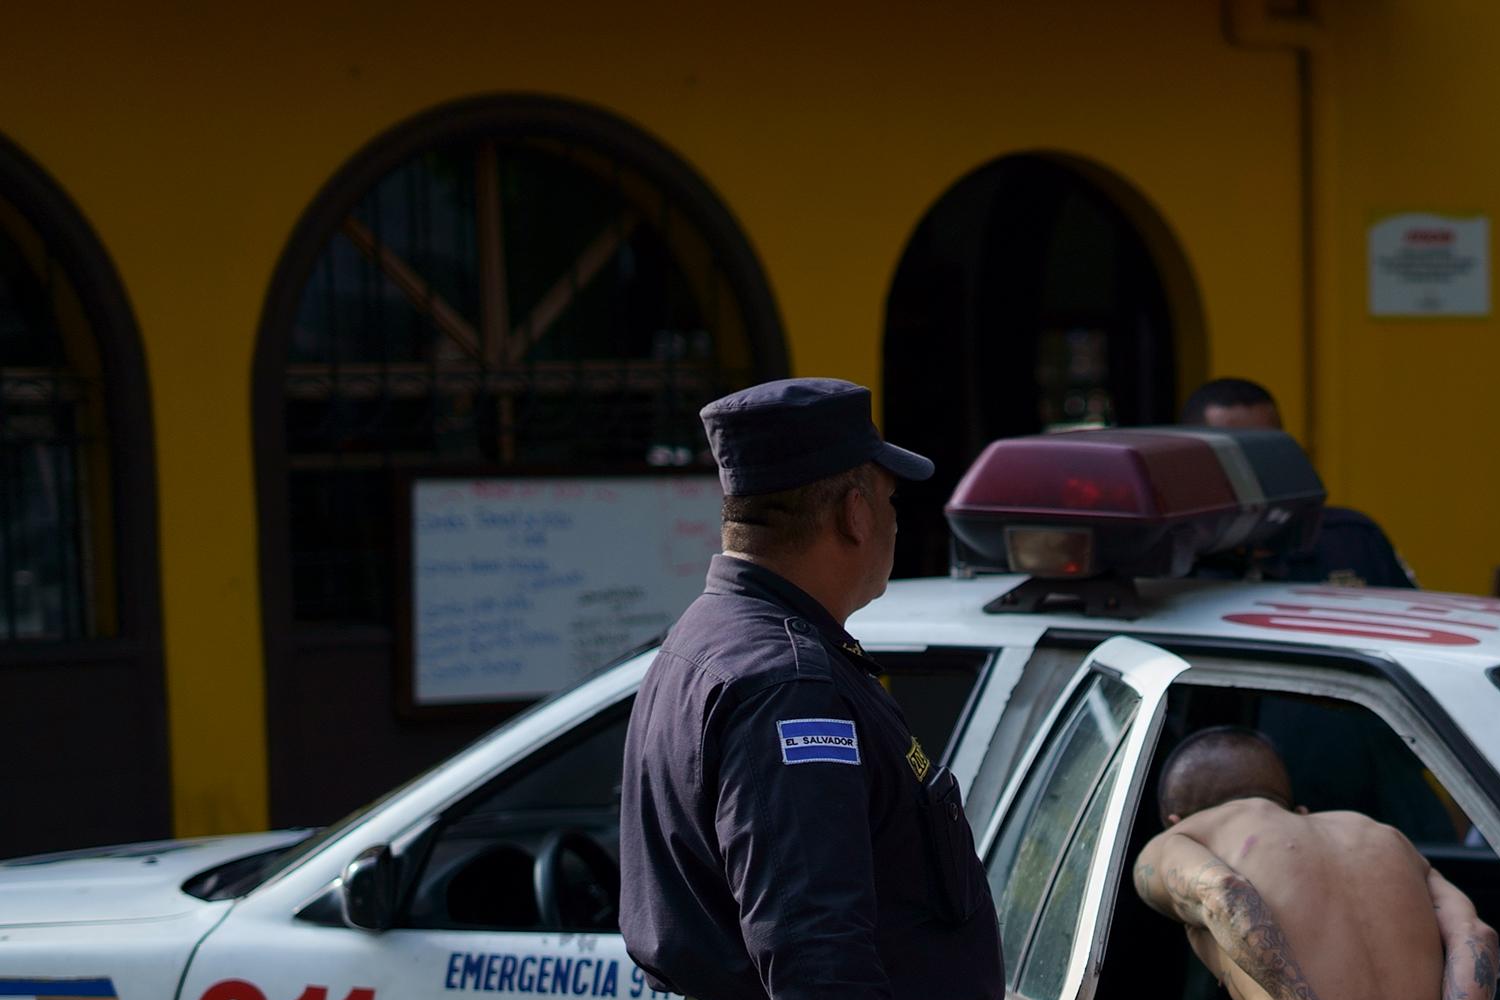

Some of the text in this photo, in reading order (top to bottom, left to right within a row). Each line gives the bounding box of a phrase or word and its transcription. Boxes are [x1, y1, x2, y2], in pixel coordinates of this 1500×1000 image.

[786, 736, 853, 747] EL SALVADOR
[444, 951, 620, 998] EMERGENCIA
